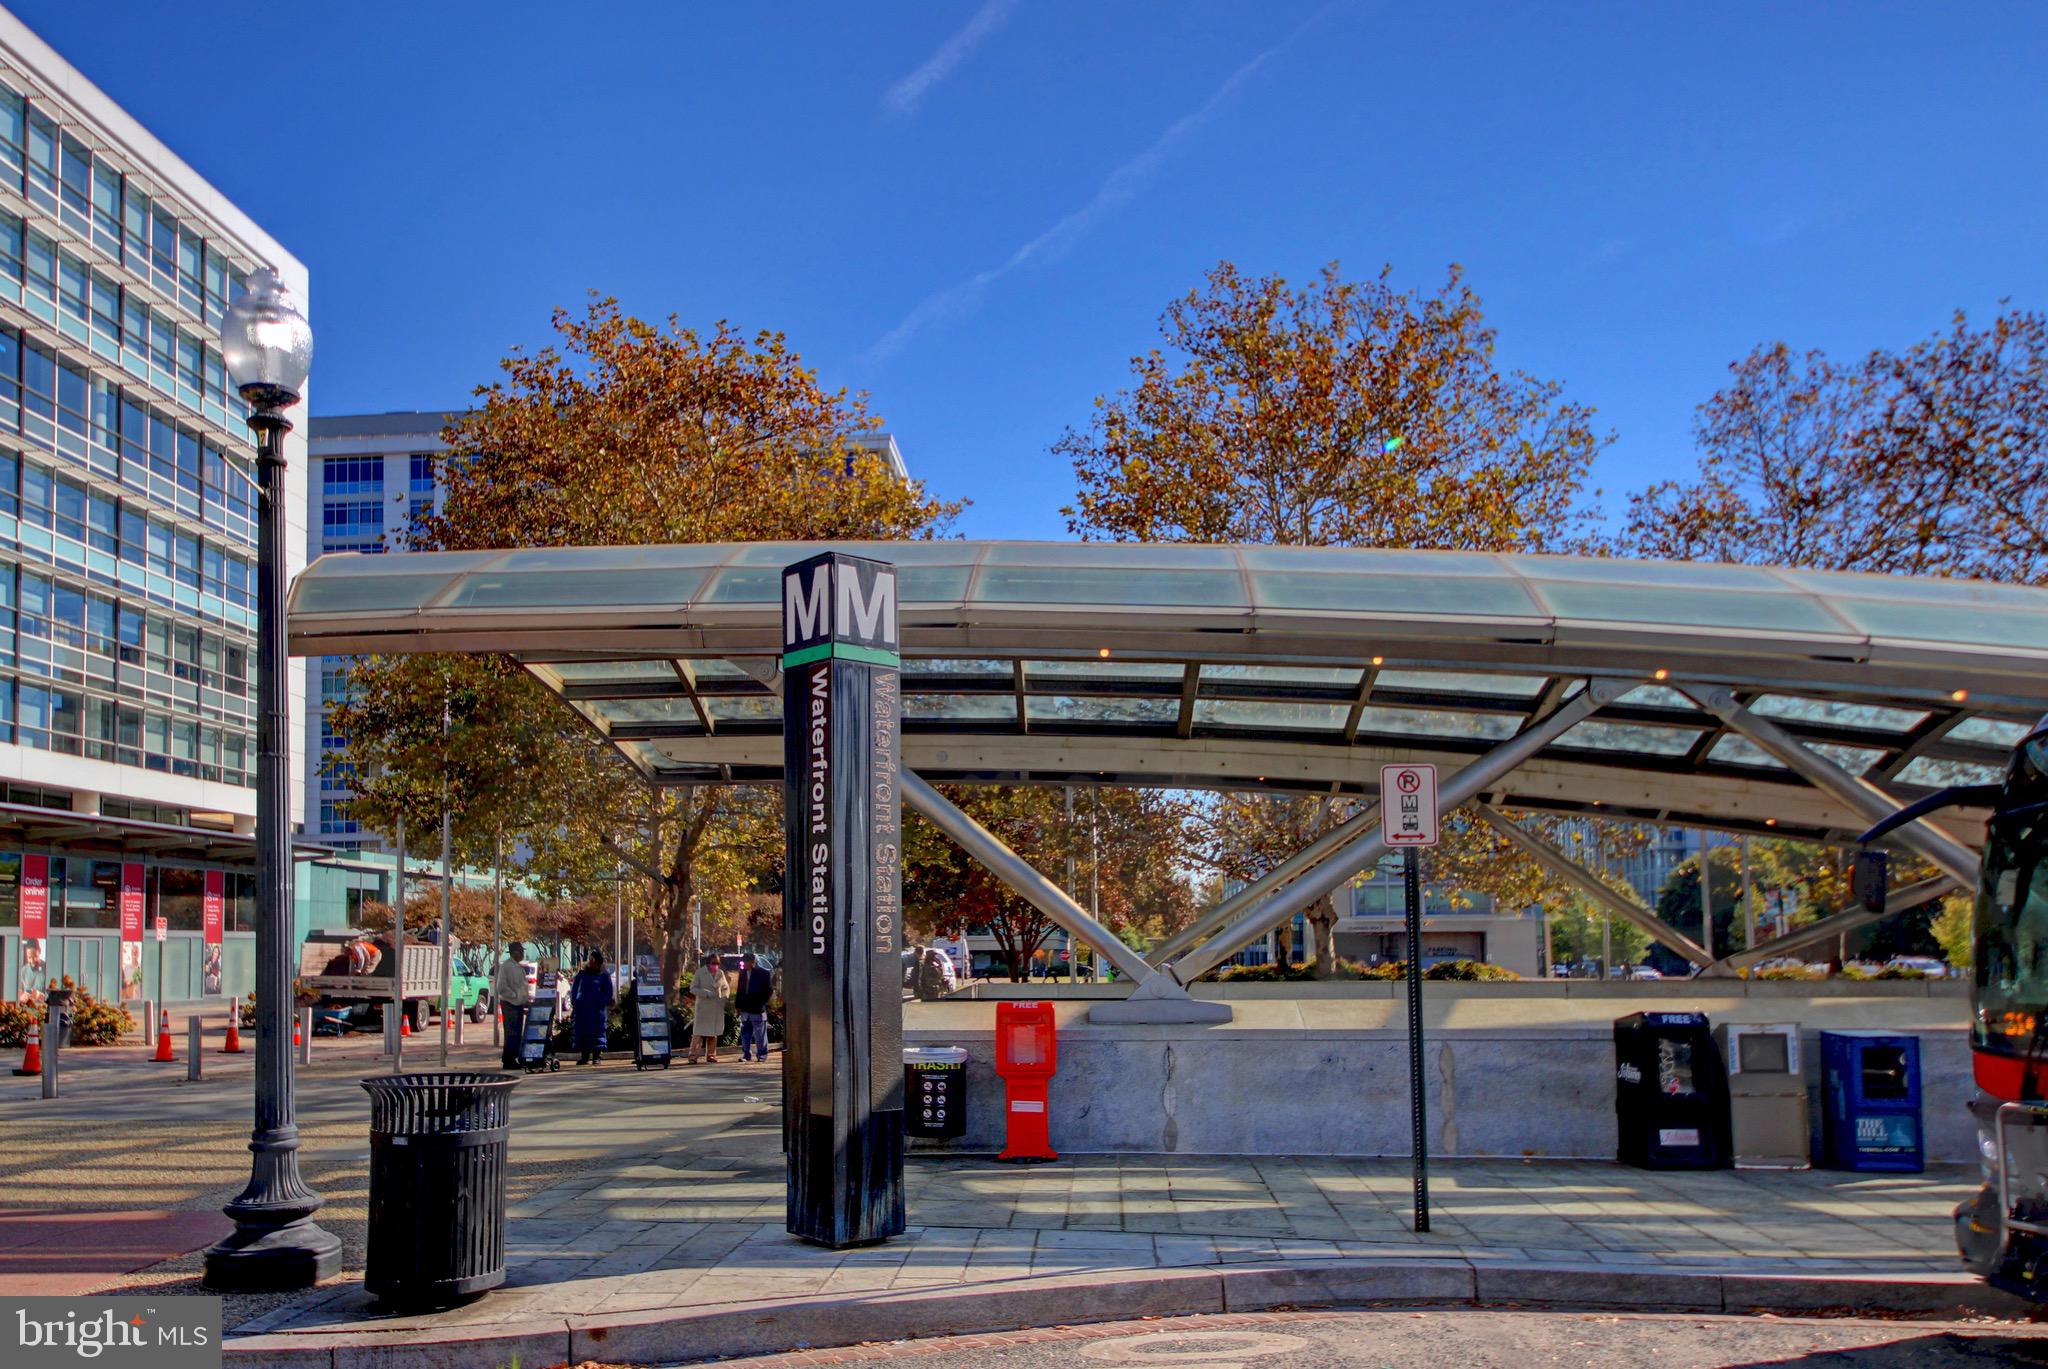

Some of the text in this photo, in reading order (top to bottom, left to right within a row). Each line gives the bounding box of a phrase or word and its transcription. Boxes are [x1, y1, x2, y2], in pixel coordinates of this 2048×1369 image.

[785, 563, 829, 646] M
[837, 563, 895, 644] M
[811, 667, 829, 955] Waterfront Station
[874, 673, 897, 953] Waterfront Station
[1402, 796, 1417, 808] M
[25, 877, 43, 886] Order
[1013, 1001, 1039, 1009] FREE
[1661, 1014, 1692, 1024] FREE
